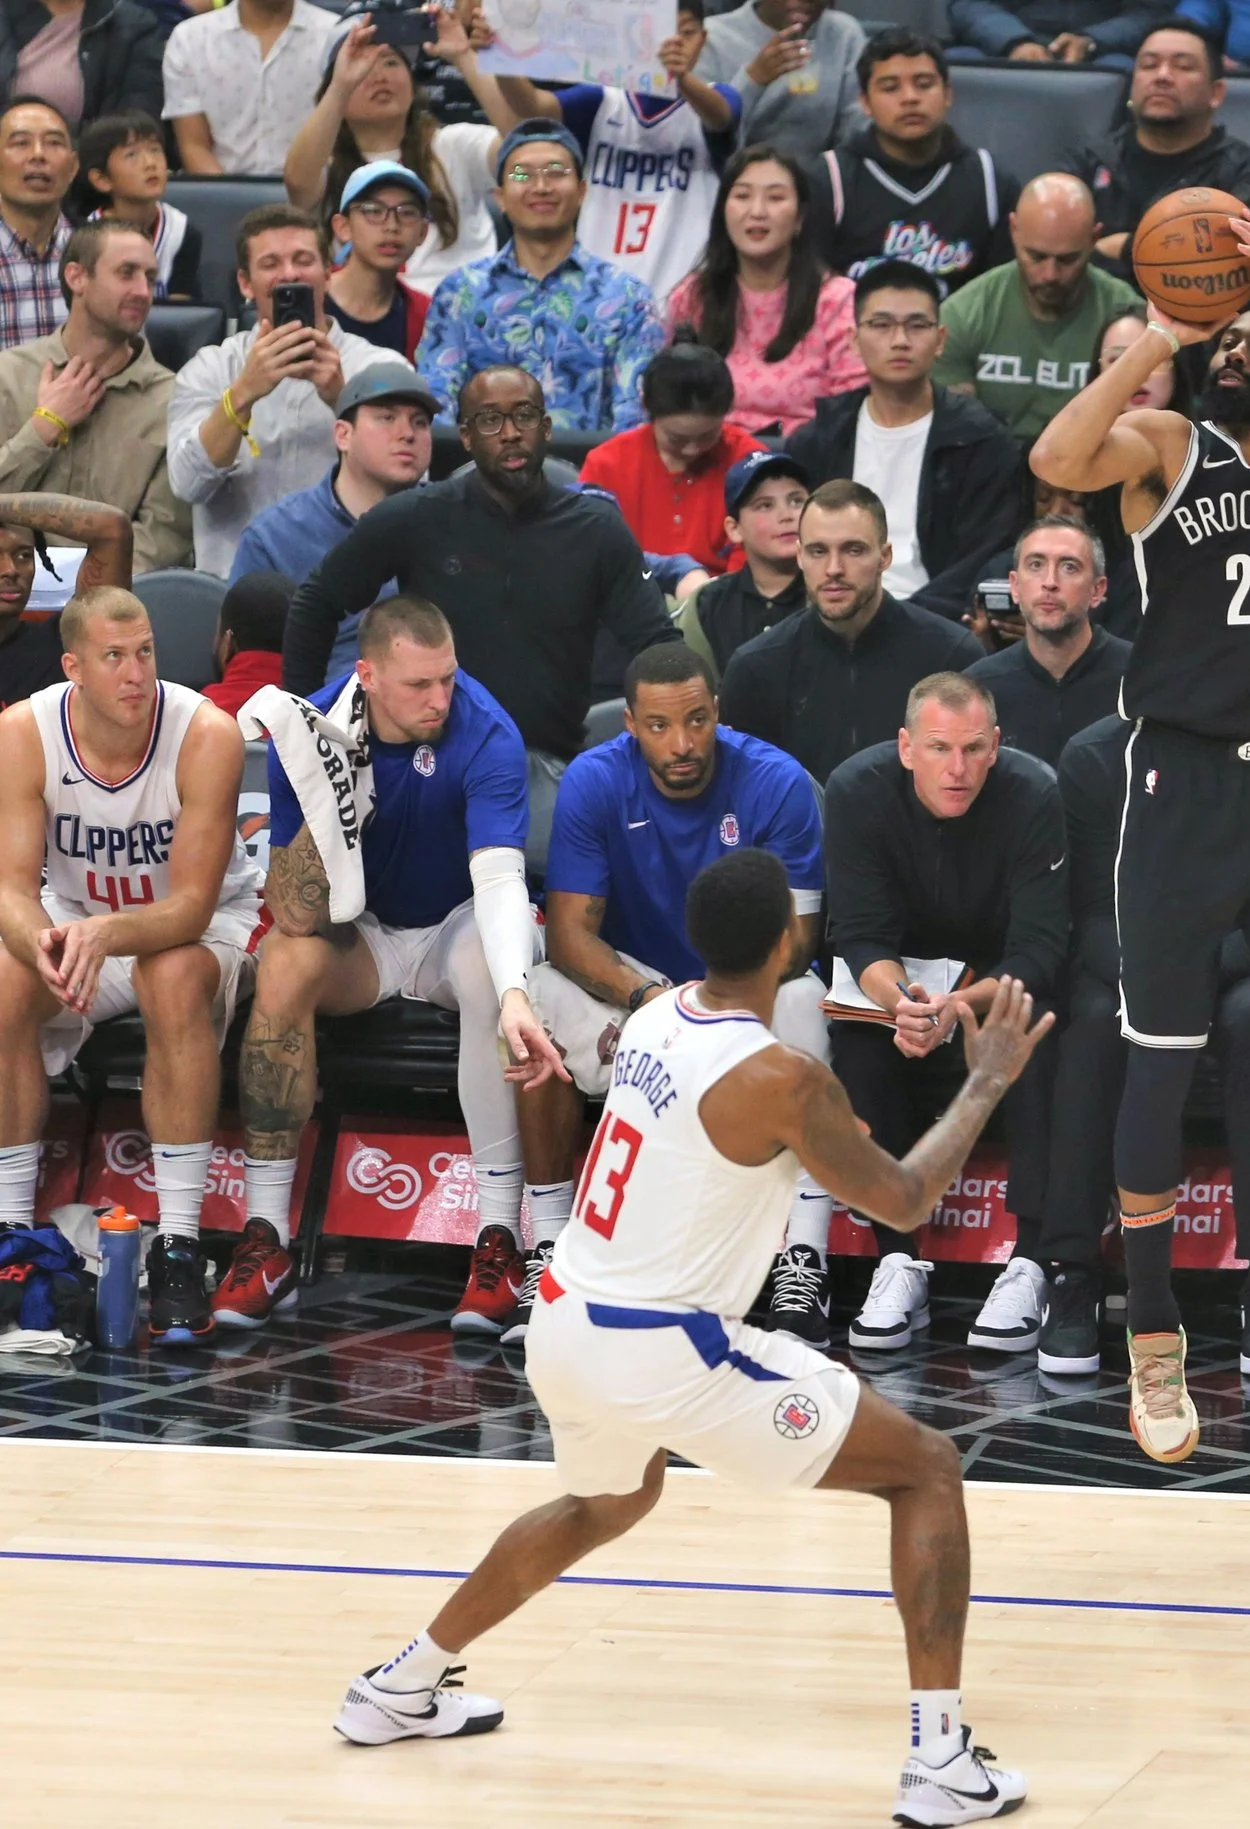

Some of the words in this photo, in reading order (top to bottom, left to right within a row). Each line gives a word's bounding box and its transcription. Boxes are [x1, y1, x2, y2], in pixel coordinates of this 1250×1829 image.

[613, 201, 657, 255] 13
[1161, 265, 1250, 297] Wilson
[55, 812, 175, 867] CLPPERS
[86, 870, 155, 913] 44
[613, 1048, 678, 1119] GEORGE
[575, 1110, 644, 1241] 13
[945, 1175, 1009, 1199] dars
[1176, 1177, 1234, 1203] dars
[928, 1202, 992, 1228] inai
[1173, 1207, 1222, 1234] nai
